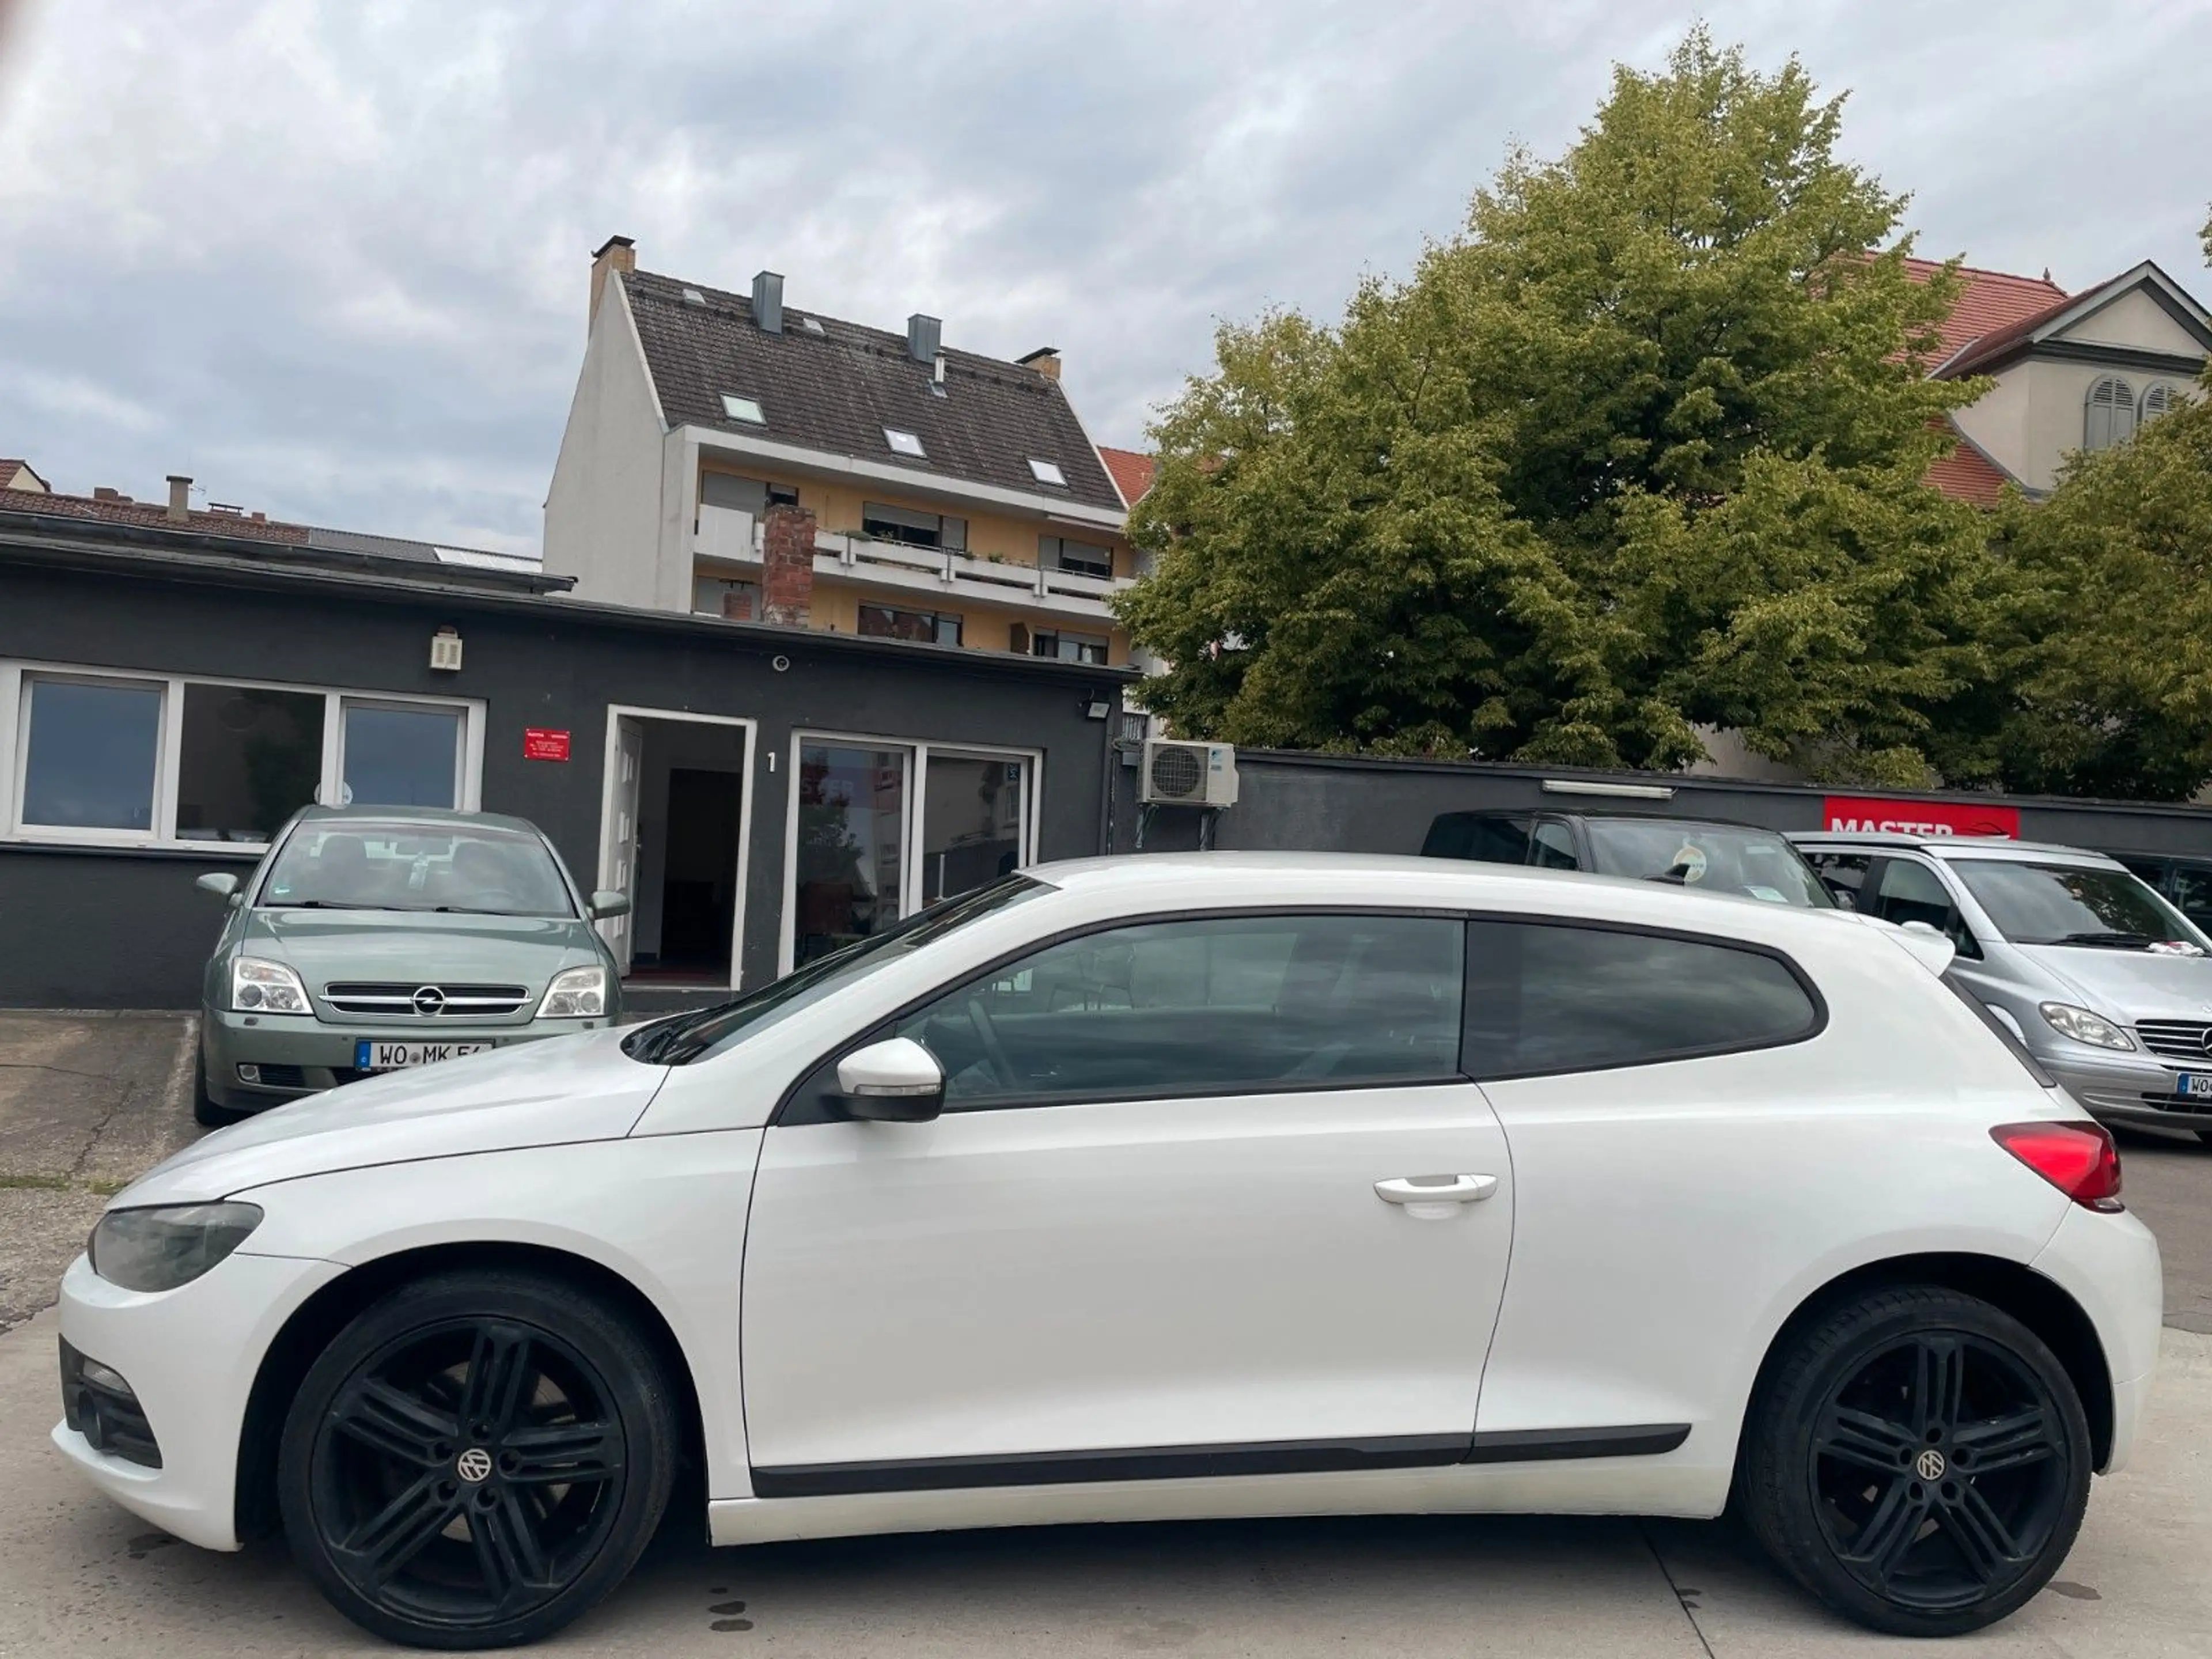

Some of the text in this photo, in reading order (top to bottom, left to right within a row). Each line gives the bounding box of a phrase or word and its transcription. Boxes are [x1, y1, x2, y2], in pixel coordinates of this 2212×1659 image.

[767, 751, 776, 772] 1
[380, 1045, 407, 1065] WO
[423, 1046, 451, 1064] MK
[2191, 1078, 2209, 1093] WO
